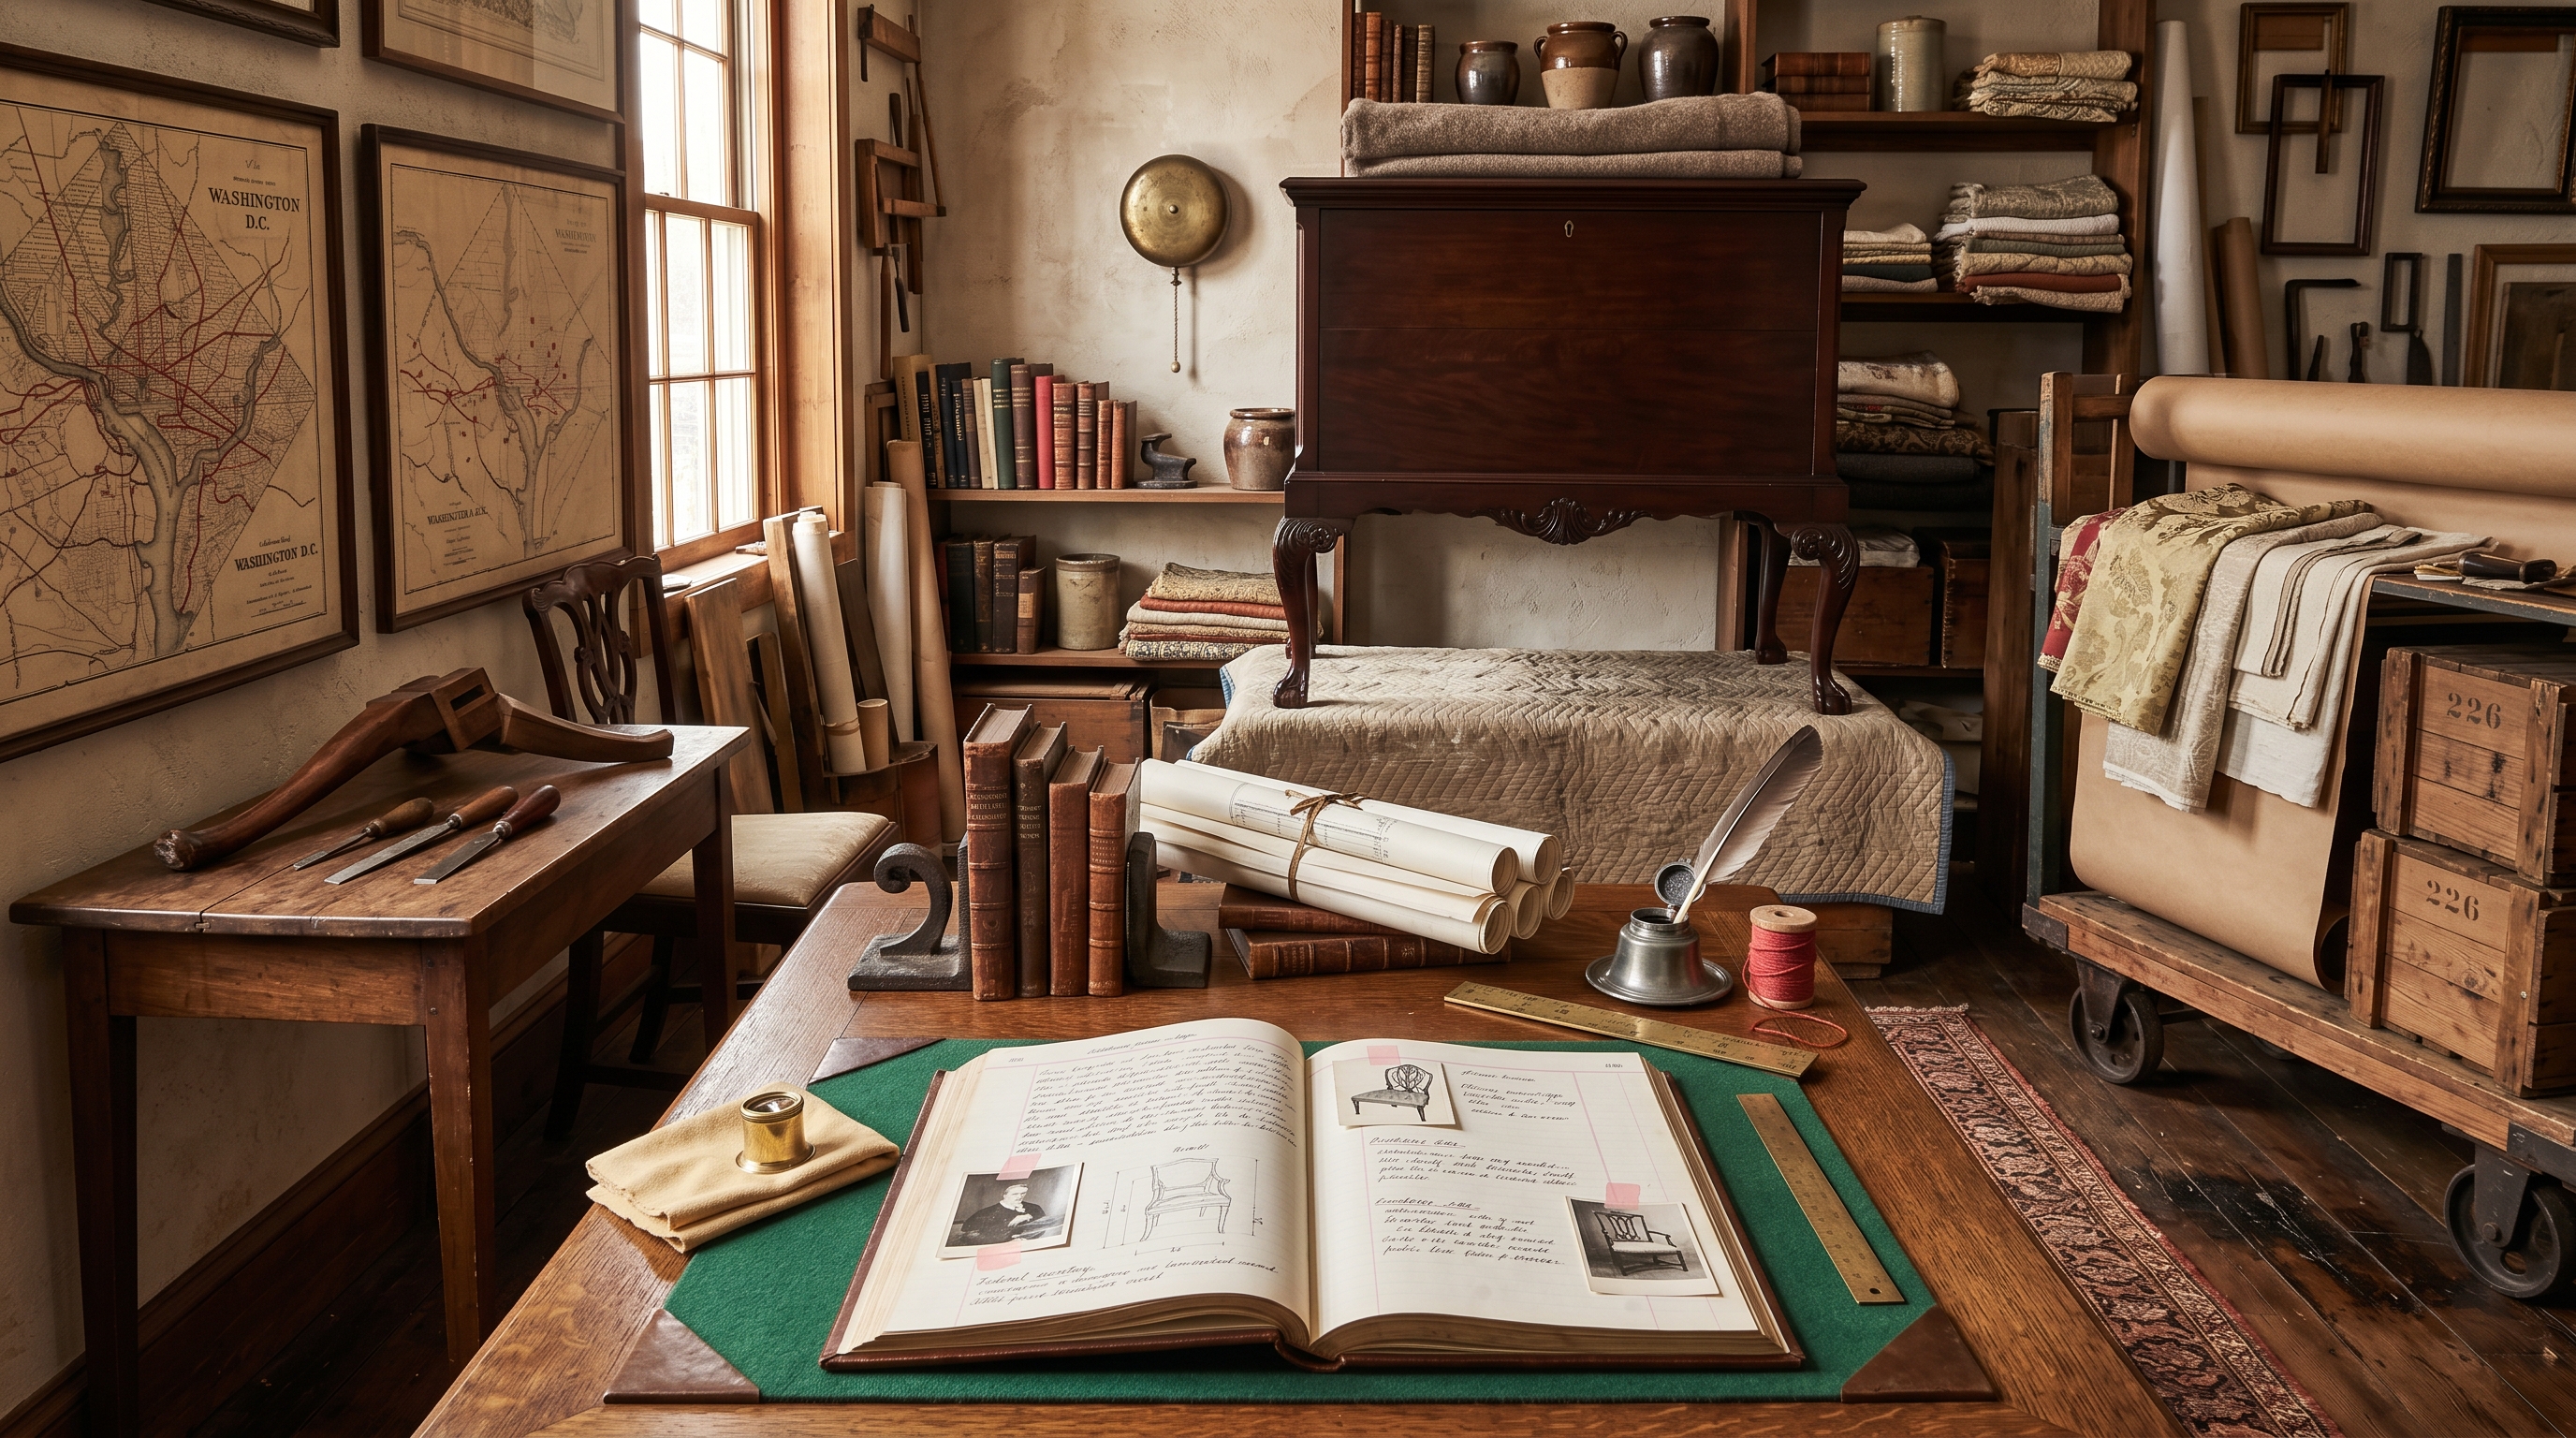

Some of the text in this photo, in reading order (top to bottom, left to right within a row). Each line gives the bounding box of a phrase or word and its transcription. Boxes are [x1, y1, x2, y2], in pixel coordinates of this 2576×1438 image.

[208, 187, 300, 213] WASHINGTON
[245, 214, 270, 230] D.C.
[300, 543, 318, 557] D.C.
[2446, 693, 2501, 729] 226
[2426, 880, 2479, 921] 226
